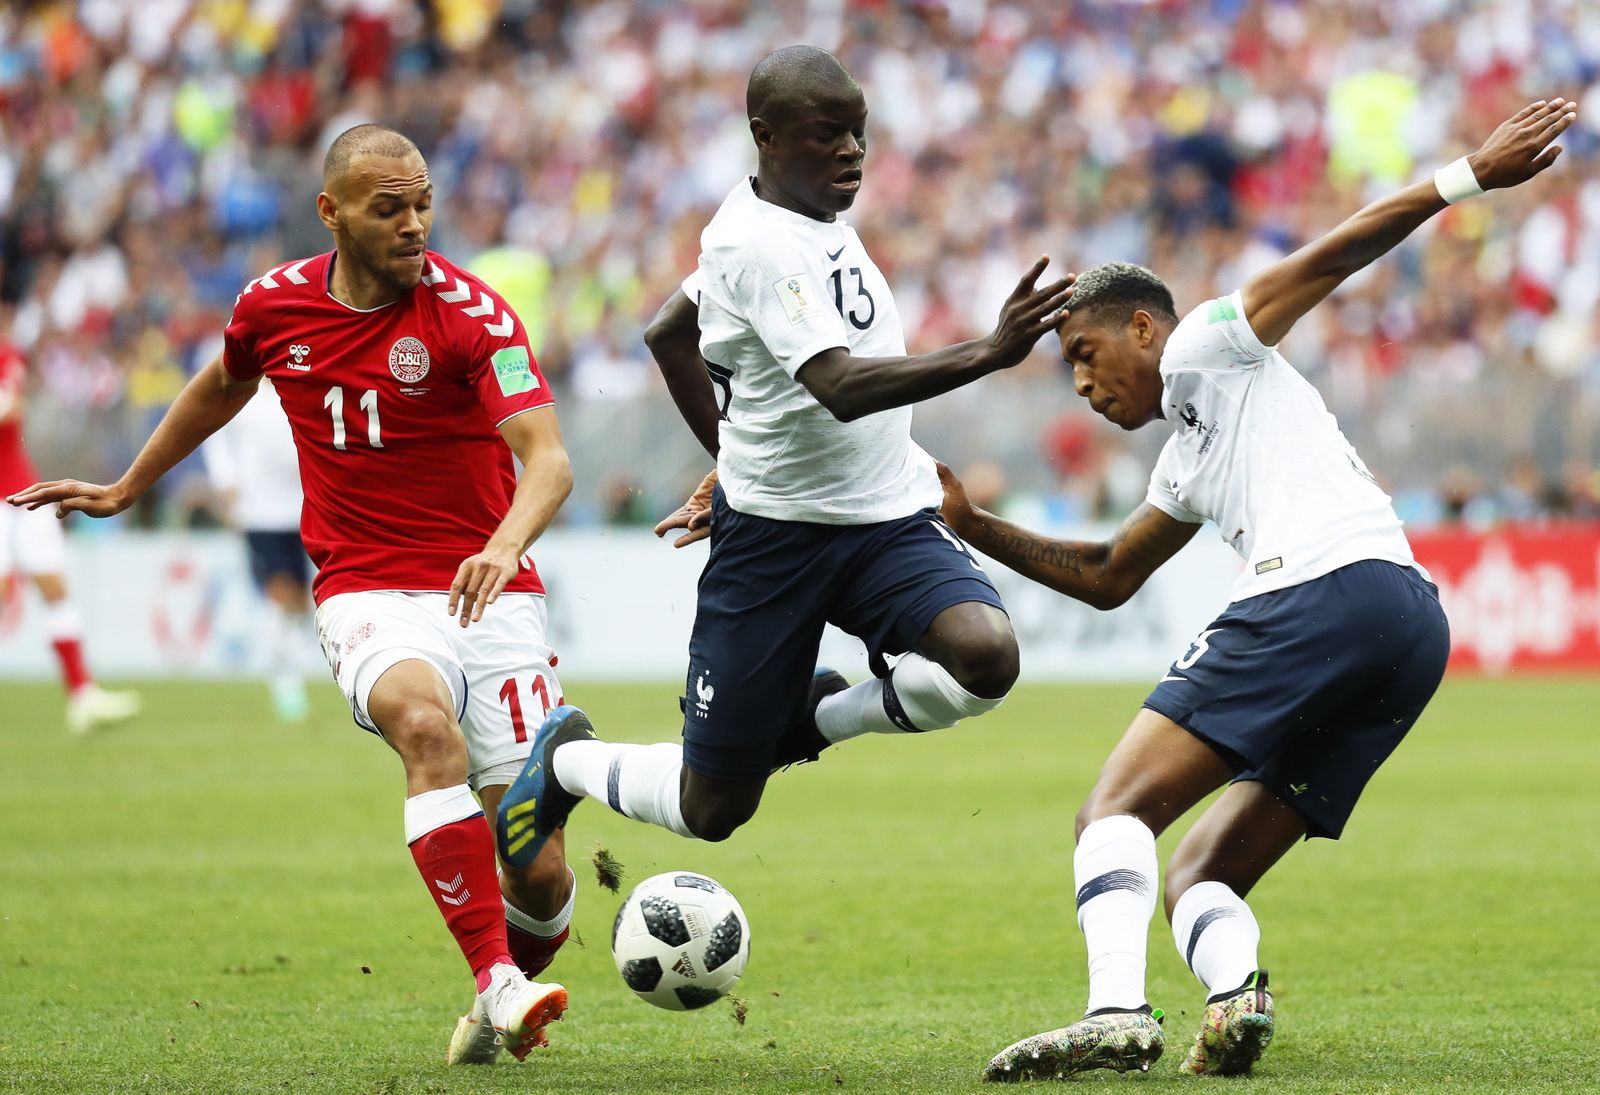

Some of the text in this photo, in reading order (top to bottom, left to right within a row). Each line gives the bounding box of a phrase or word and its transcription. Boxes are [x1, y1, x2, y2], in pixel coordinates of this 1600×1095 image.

[830, 267, 875, 330] 13
[398, 352, 420, 366] DBU
[324, 386, 384, 450] 11
[499, 675, 550, 743] 11
[681, 951, 697, 979] adidas
